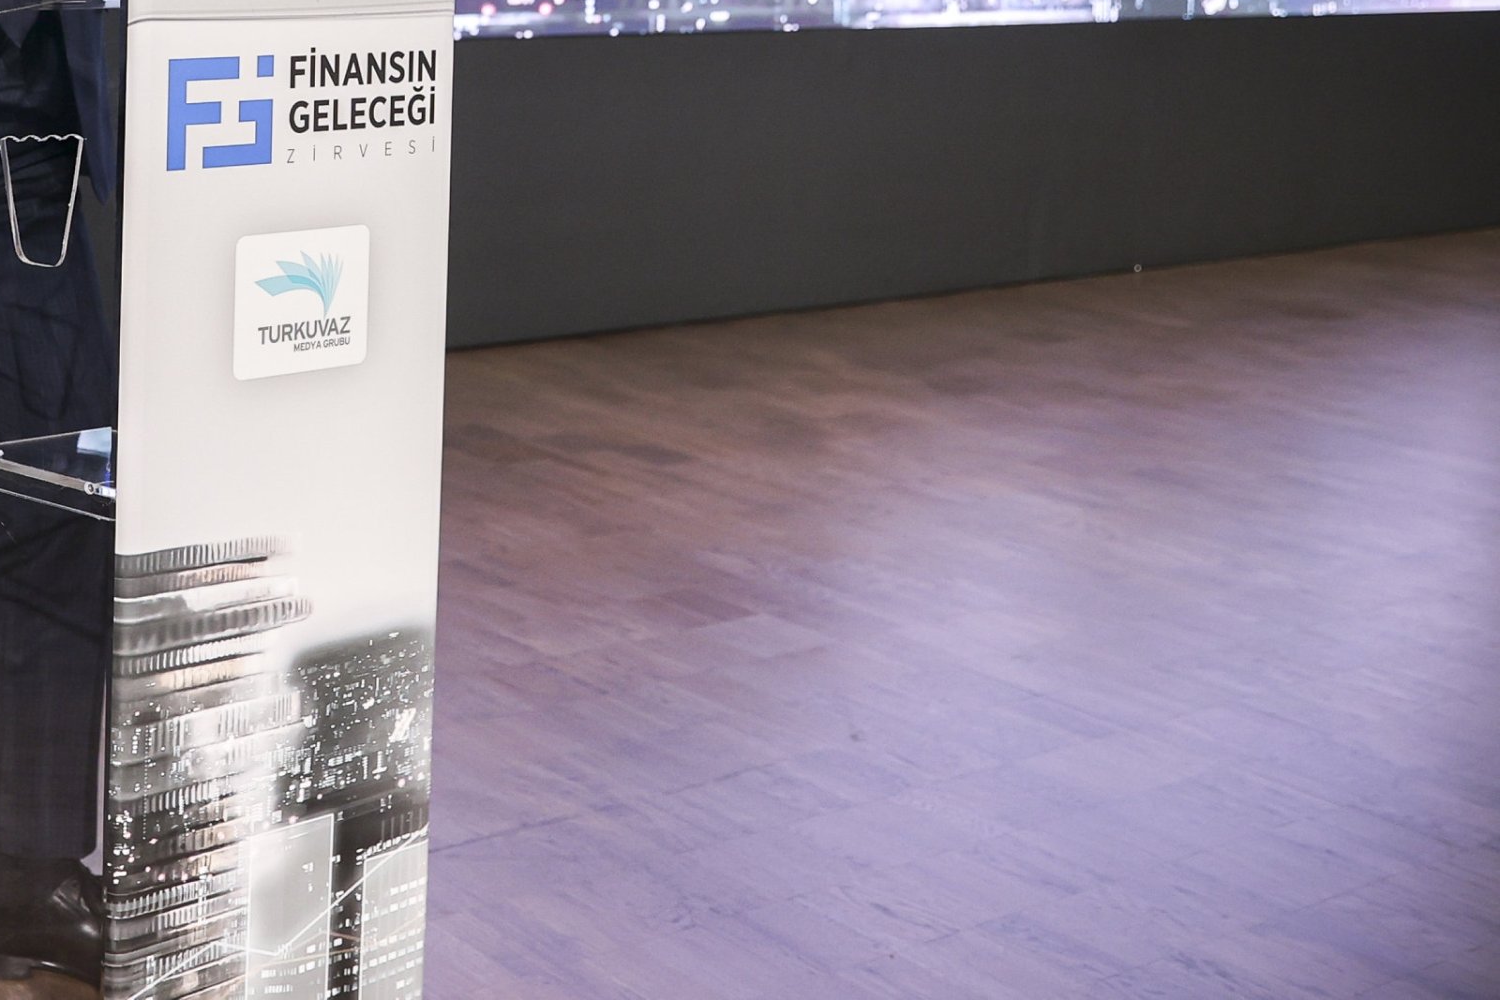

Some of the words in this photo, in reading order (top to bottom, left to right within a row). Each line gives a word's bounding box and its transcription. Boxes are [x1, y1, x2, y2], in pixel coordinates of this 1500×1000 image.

[290, 47, 436, 88] FİNANSIN
[289, 86, 436, 134] GELECEĞİ
[286, 136, 436, 164] ZİRVESİ
[258, 316, 351, 344] TURKUVAZ
[293, 341, 322, 352] MEDYA
[323, 337, 351, 348] GRUBU
